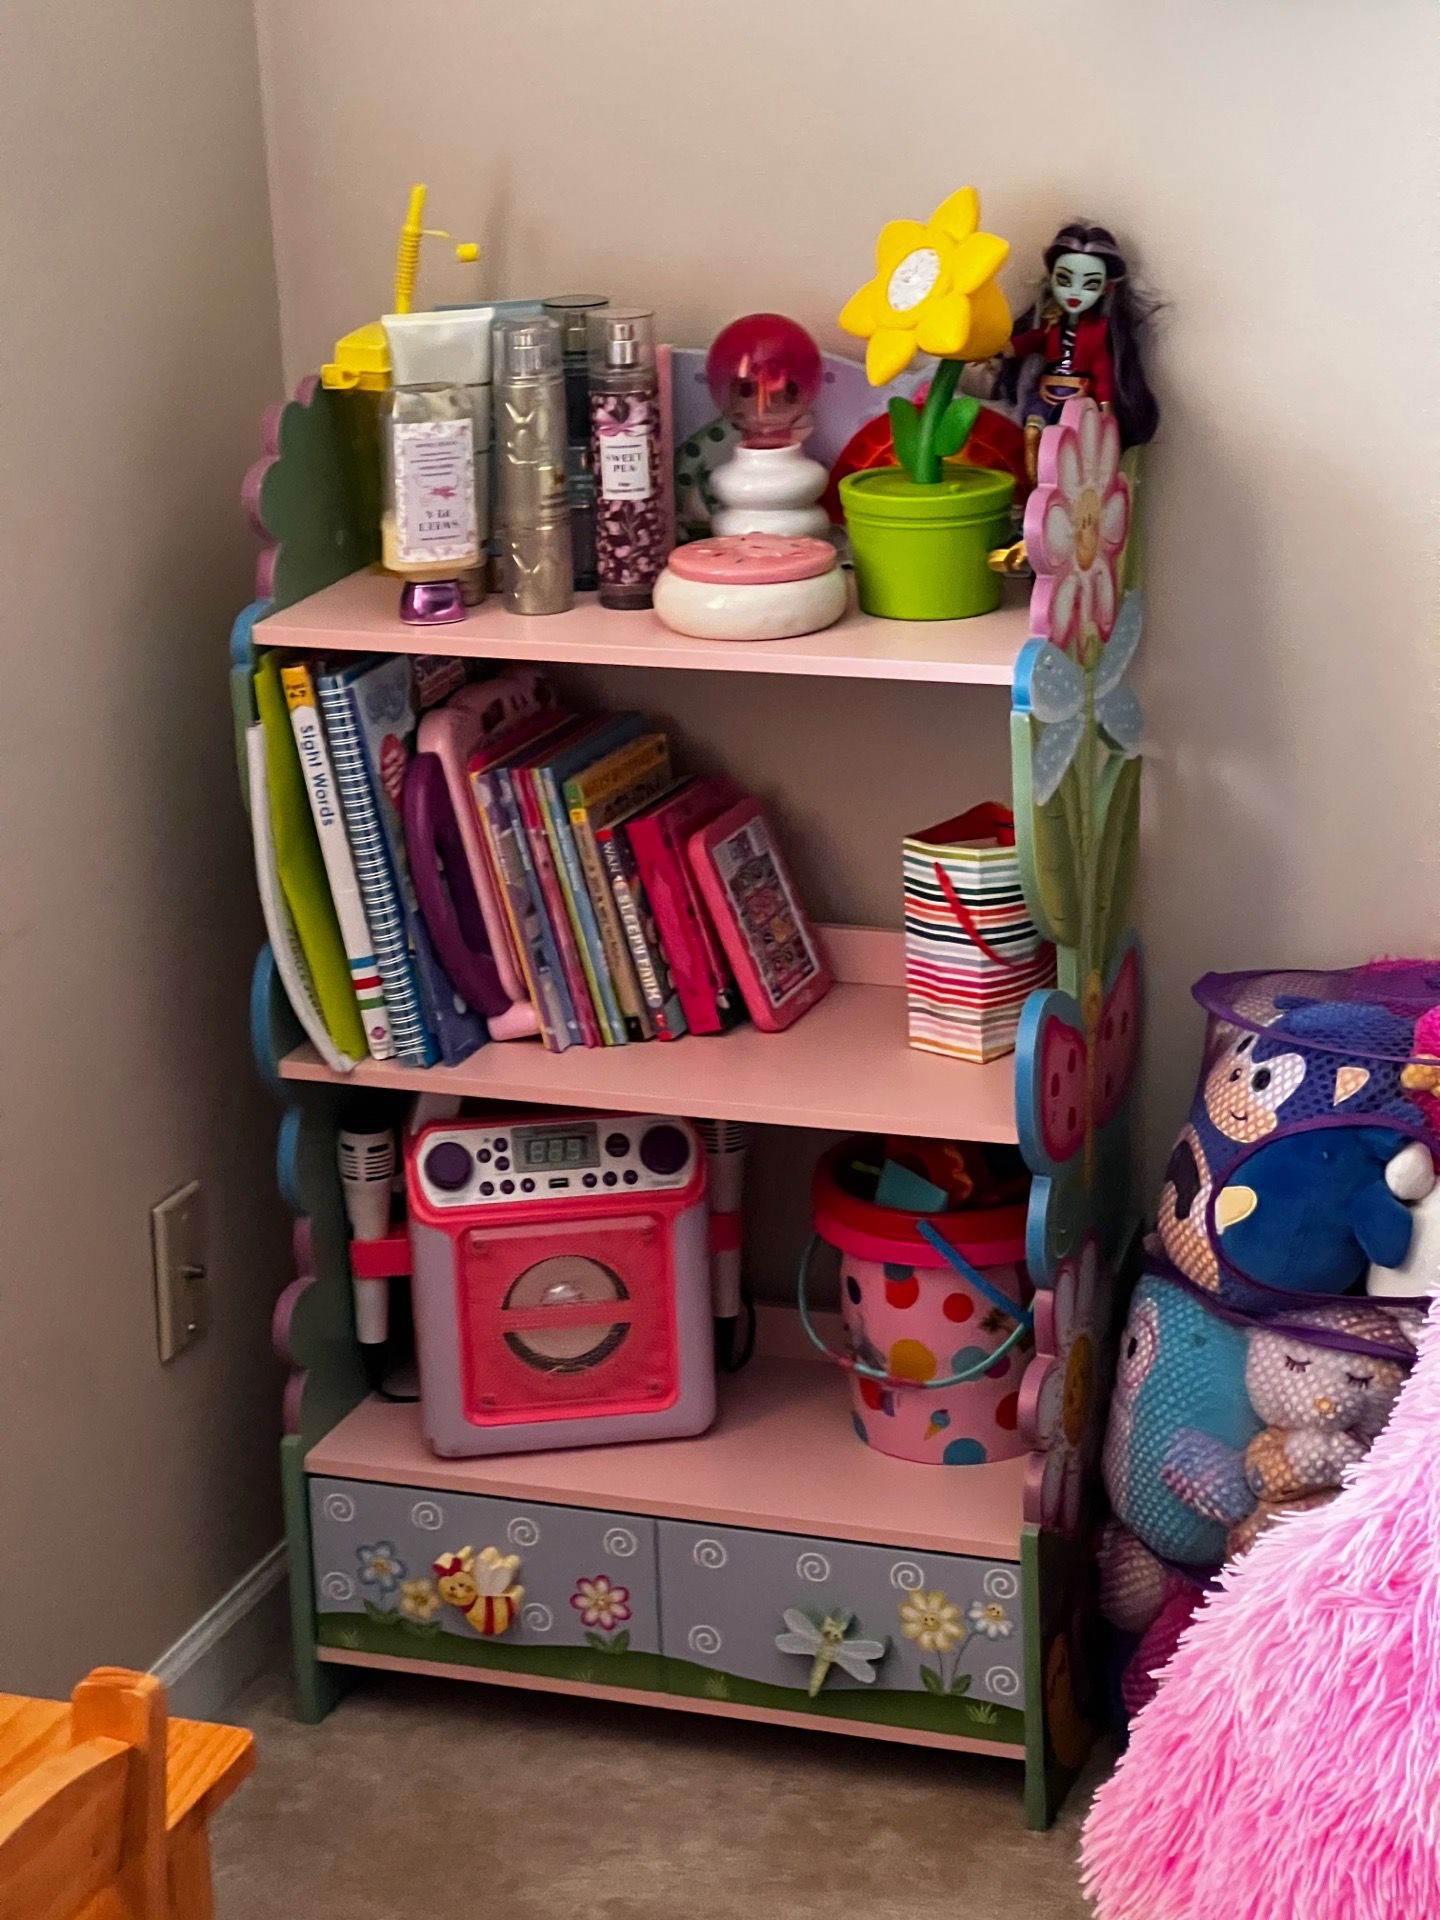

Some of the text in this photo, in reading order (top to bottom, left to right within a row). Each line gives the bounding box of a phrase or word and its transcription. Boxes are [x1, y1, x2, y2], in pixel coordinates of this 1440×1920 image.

[605, 452, 642, 462] SWEET
[613, 464, 636, 472] PEA
[300, 724, 335, 827] Sight Words
[603, 841, 621, 873] WAN
[619, 894, 662, 1000] SLEEPY FARM
